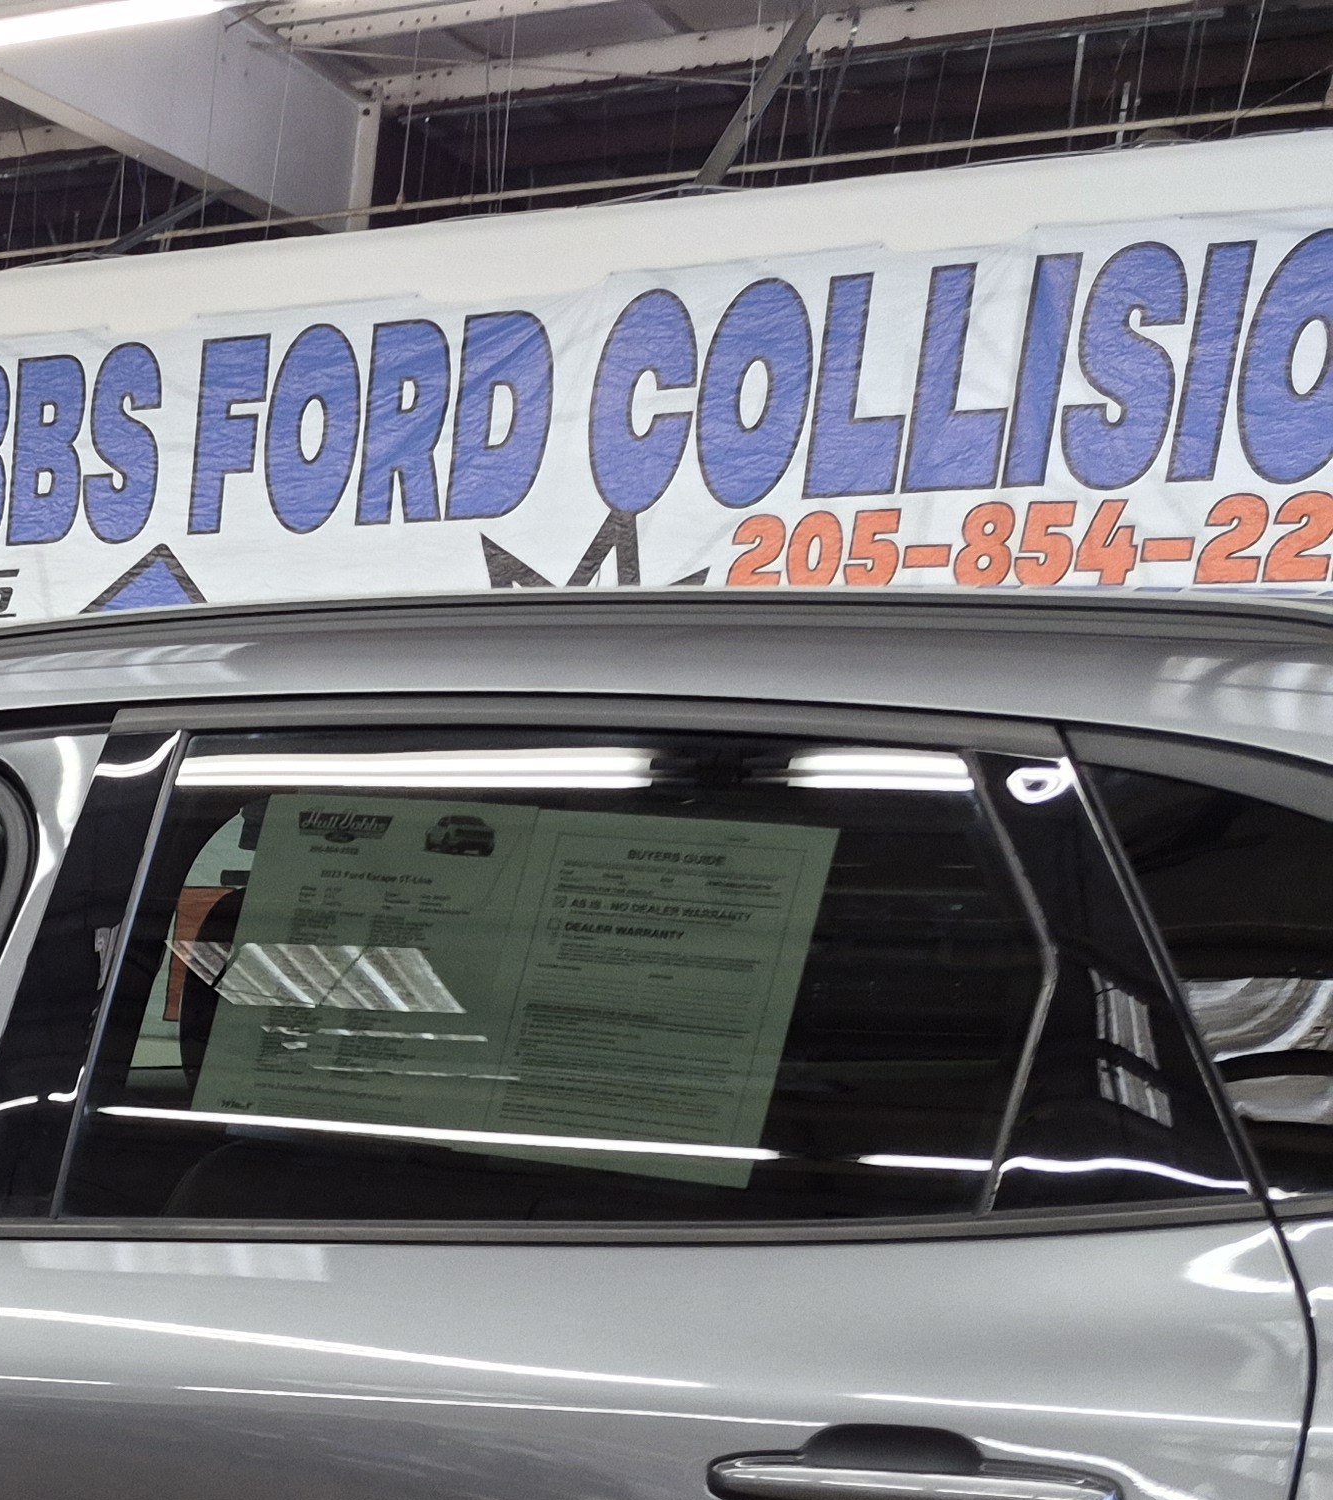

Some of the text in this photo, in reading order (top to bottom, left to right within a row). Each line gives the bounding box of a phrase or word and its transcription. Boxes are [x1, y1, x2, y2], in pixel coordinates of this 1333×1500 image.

[187, 309, 554, 535] FORD
[588, 228, 1333, 515] COLLISIO
[627, 848, 727, 866] BUYERS GUIDE
[344, 870, 365, 880] Ford
[610, 901, 629, 912] NO
[630, 903, 680, 917] DEALER
[681, 907, 753, 922] WARRANTY
[564, 921, 685, 940] DEALER WARRANTY
